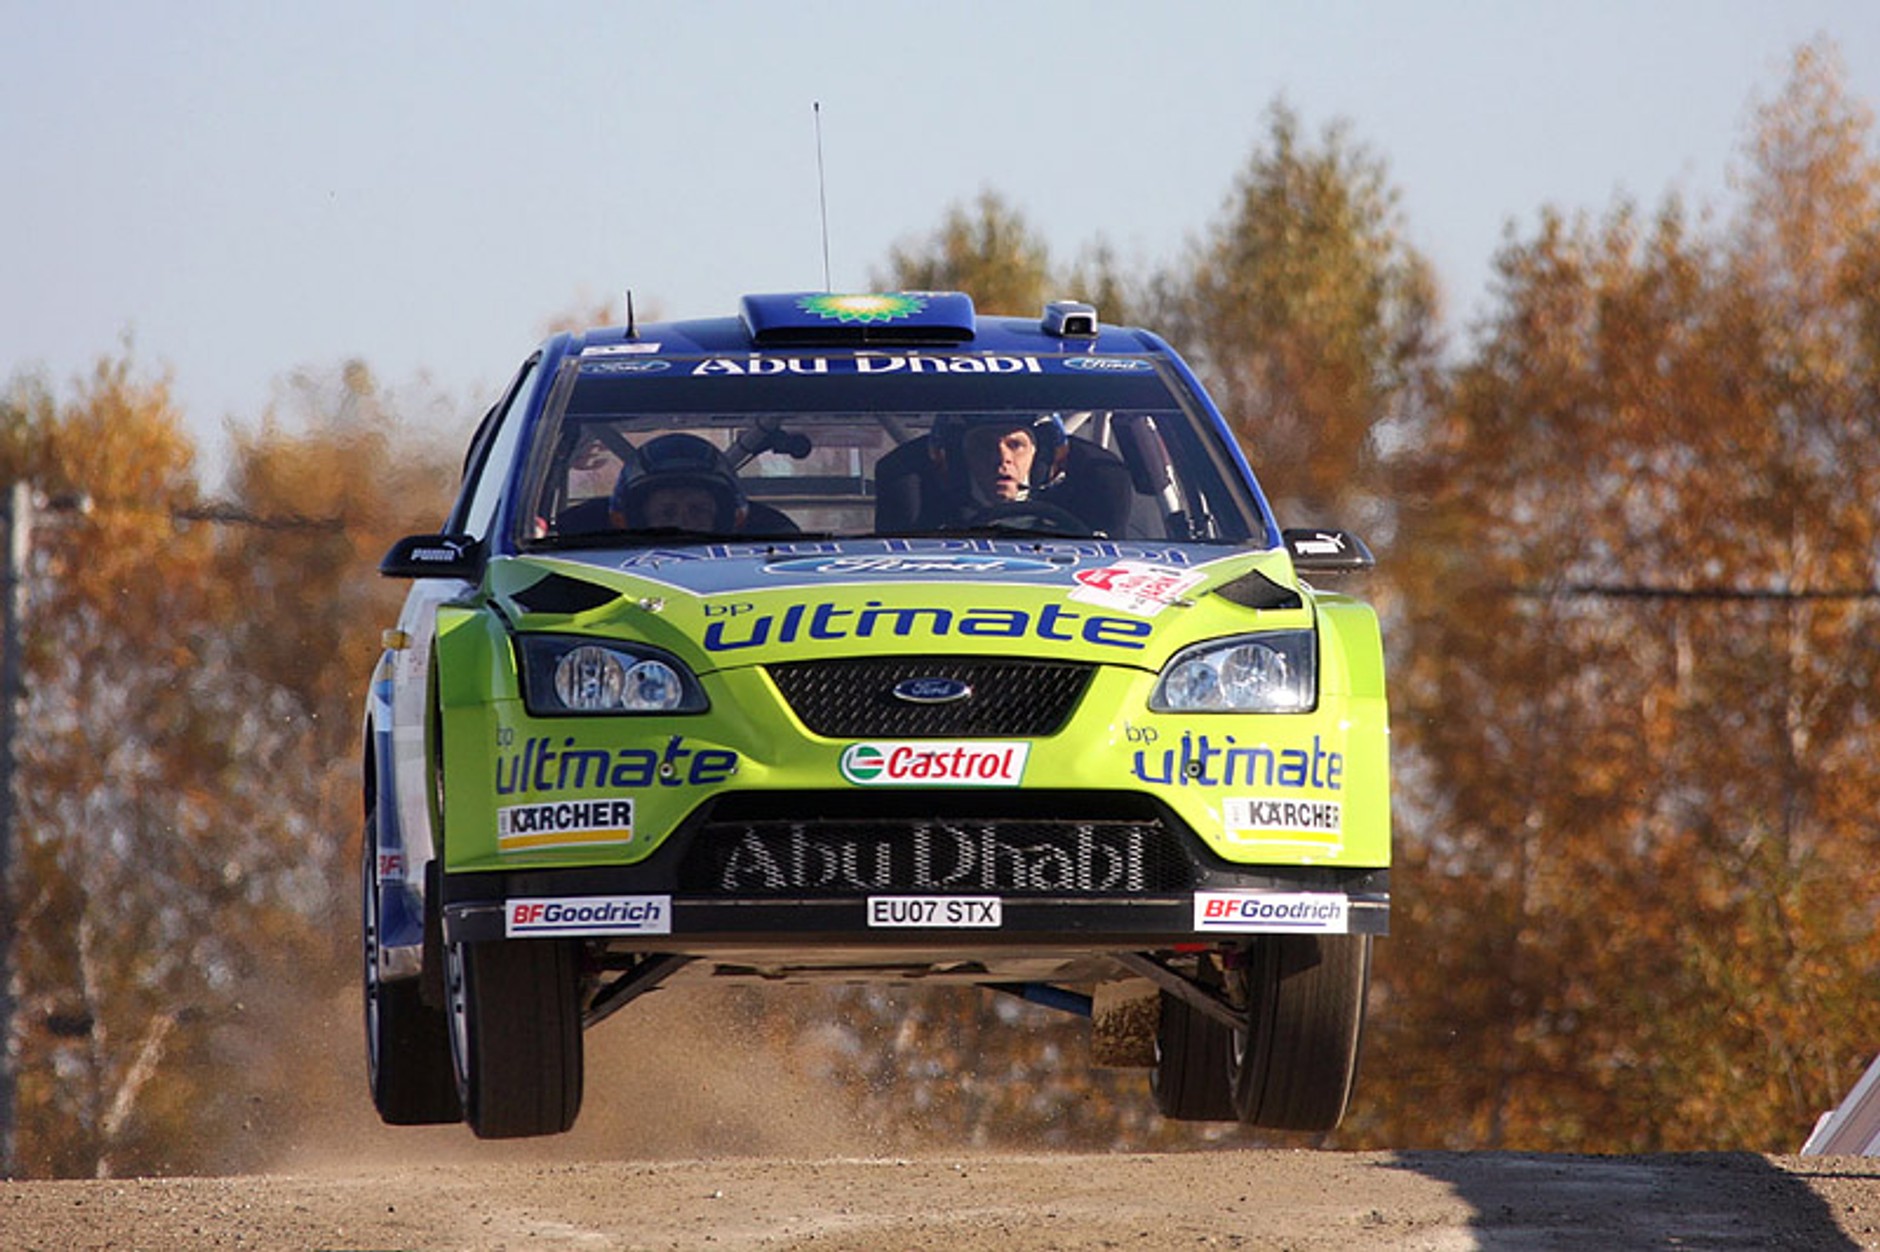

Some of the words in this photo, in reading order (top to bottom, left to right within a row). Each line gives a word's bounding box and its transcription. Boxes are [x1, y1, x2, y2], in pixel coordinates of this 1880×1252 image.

[692, 353, 829, 376] Abu
[853, 351, 1043, 375] Dhabi
[815, 557, 1005, 573] Ford
[704, 603, 754, 617] bp
[703, 601, 1153, 652] ultimate
[911, 682, 951, 695] Ford
[1125, 722, 1159, 746] bp
[496, 735, 739, 795] ultimate
[887, 746, 1014, 779] Castrol
[1133, 735, 1343, 790] ultimate
[510, 801, 632, 834] KÄRCHER
[722, 825, 891, 890] Abu
[913, 823, 1144, 892] Dhabi
[512, 902, 660, 925] BFGoodrich
[874, 900, 938, 923] EU07
[946, 900, 995, 923] STX
[1203, 899, 1341, 920] BFGoodrich
